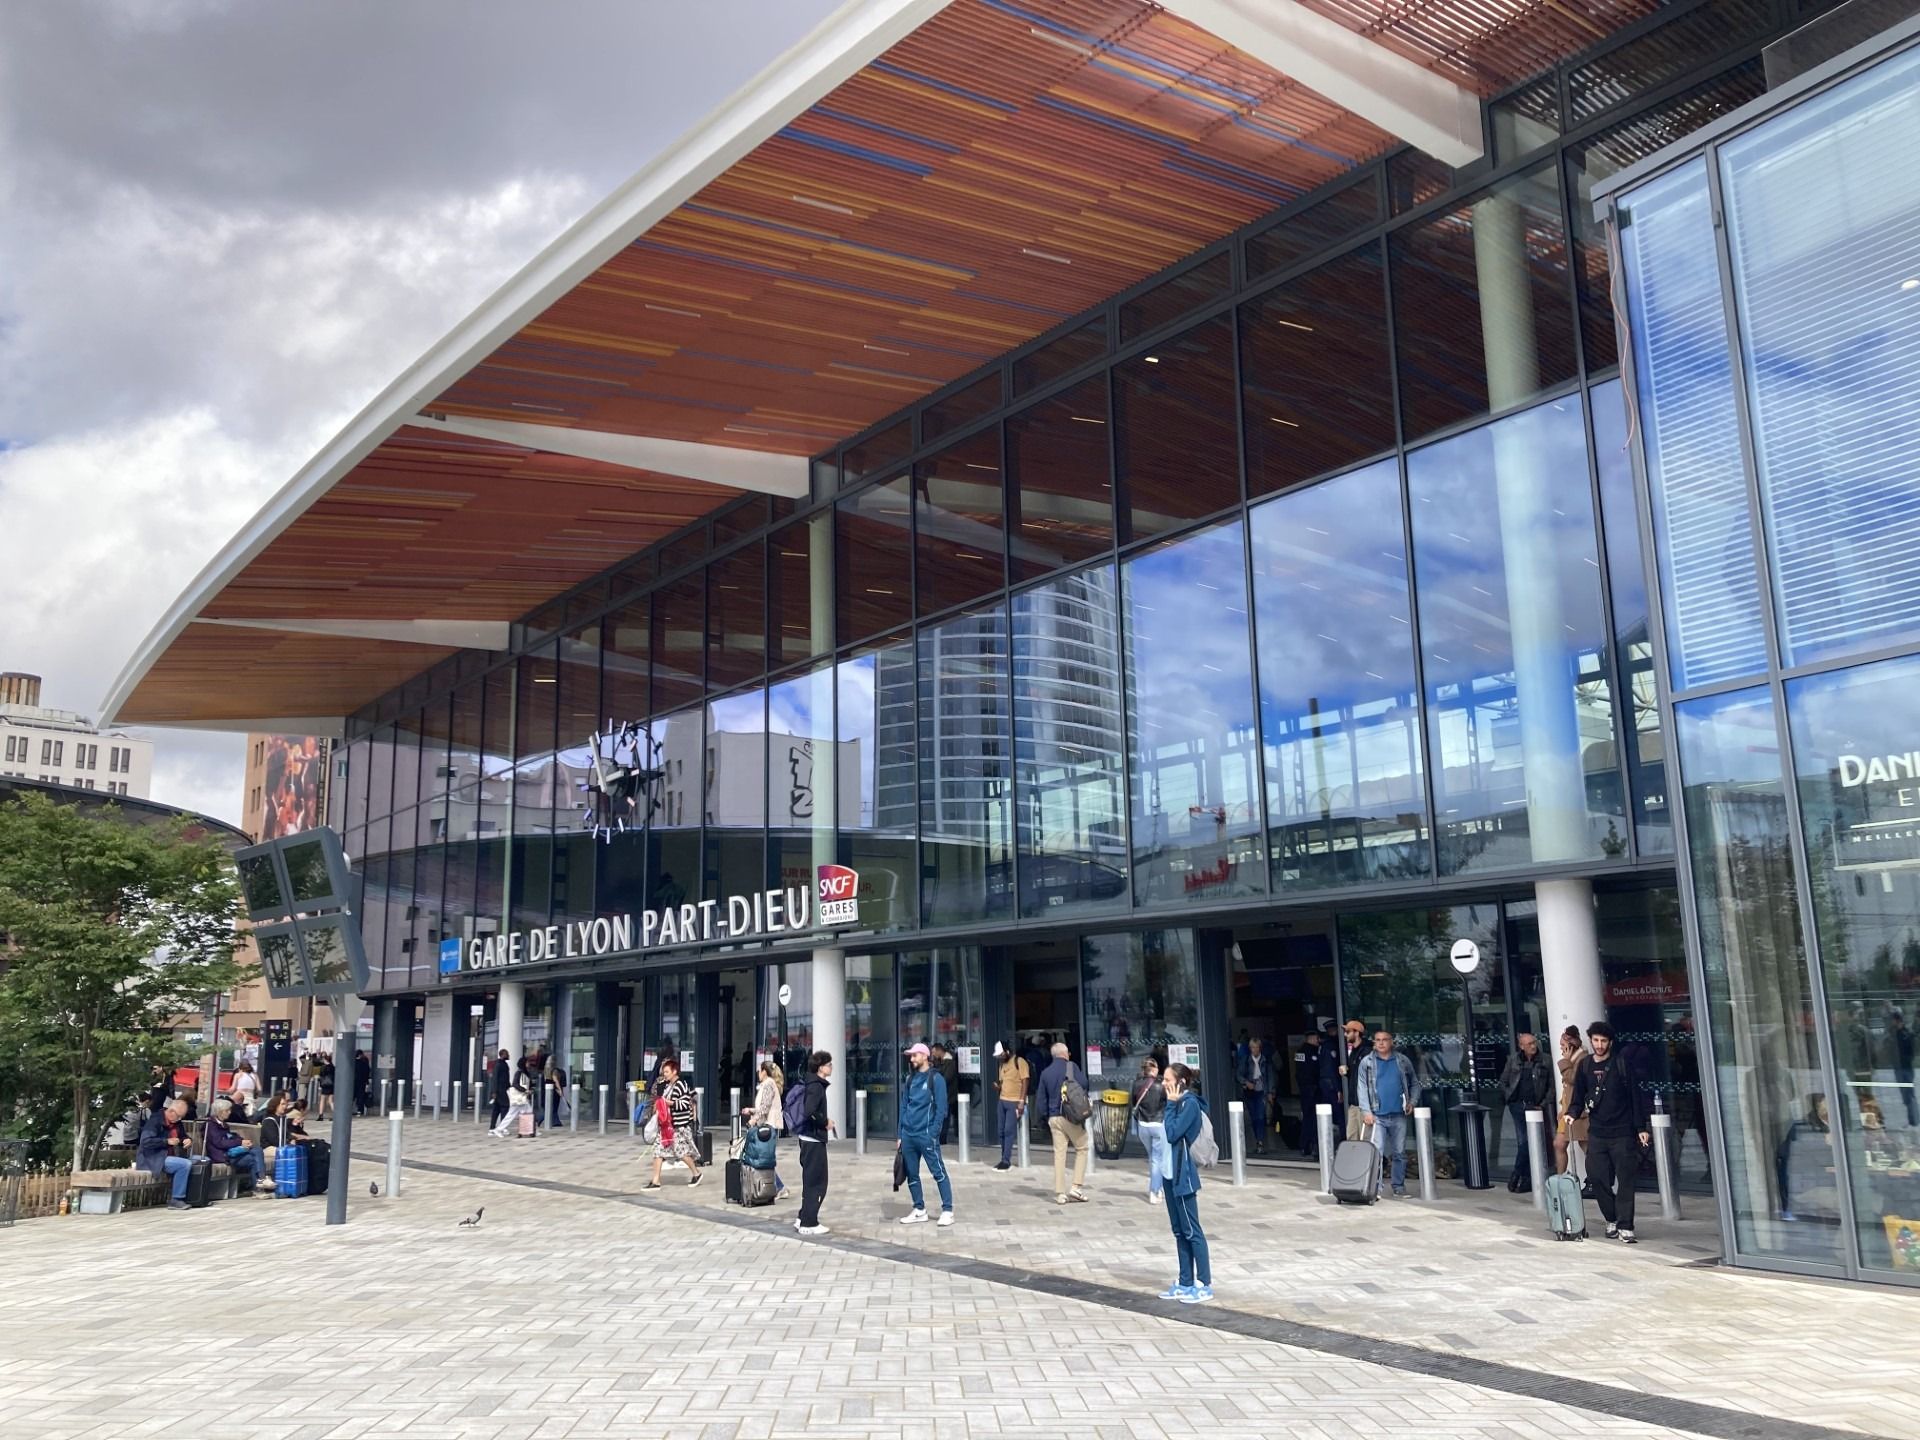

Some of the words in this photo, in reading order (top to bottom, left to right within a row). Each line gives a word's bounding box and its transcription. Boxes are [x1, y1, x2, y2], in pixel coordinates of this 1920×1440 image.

[820, 875, 851, 897] SNCF
[821, 901, 854, 916] GARES
[469, 932, 521, 970] GARE
[530, 926, 558, 962] DE
[566, 914, 631, 957] LYON
[643, 885, 809, 947] PART-DIEU
